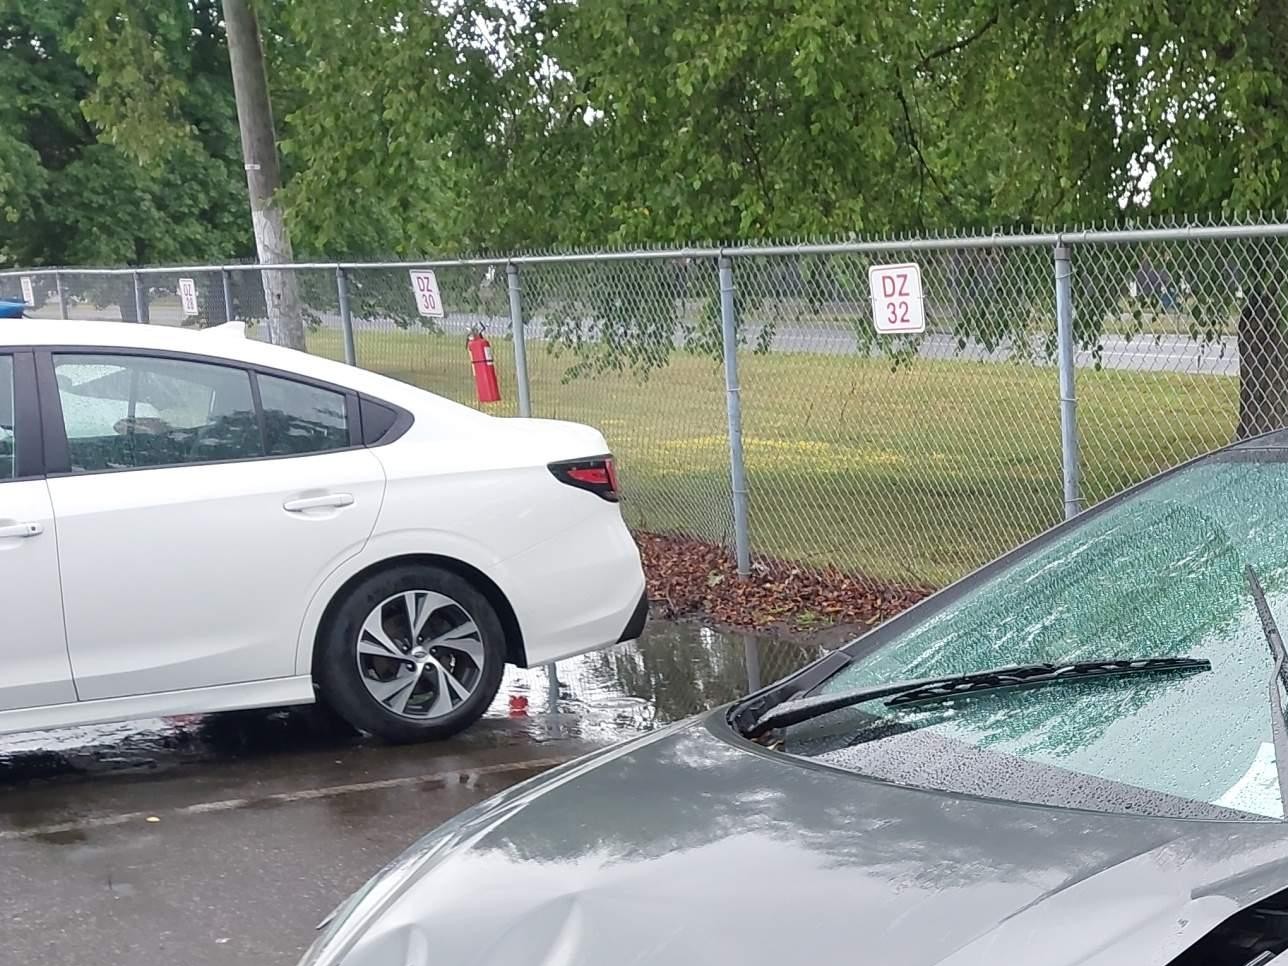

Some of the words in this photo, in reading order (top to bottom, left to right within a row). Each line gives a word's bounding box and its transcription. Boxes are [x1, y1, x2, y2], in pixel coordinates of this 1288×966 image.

[416, 276, 433, 292] DZ
[882, 274, 910, 298] DZ
[422, 294, 436, 310] 30
[886, 300, 910, 324] 32
